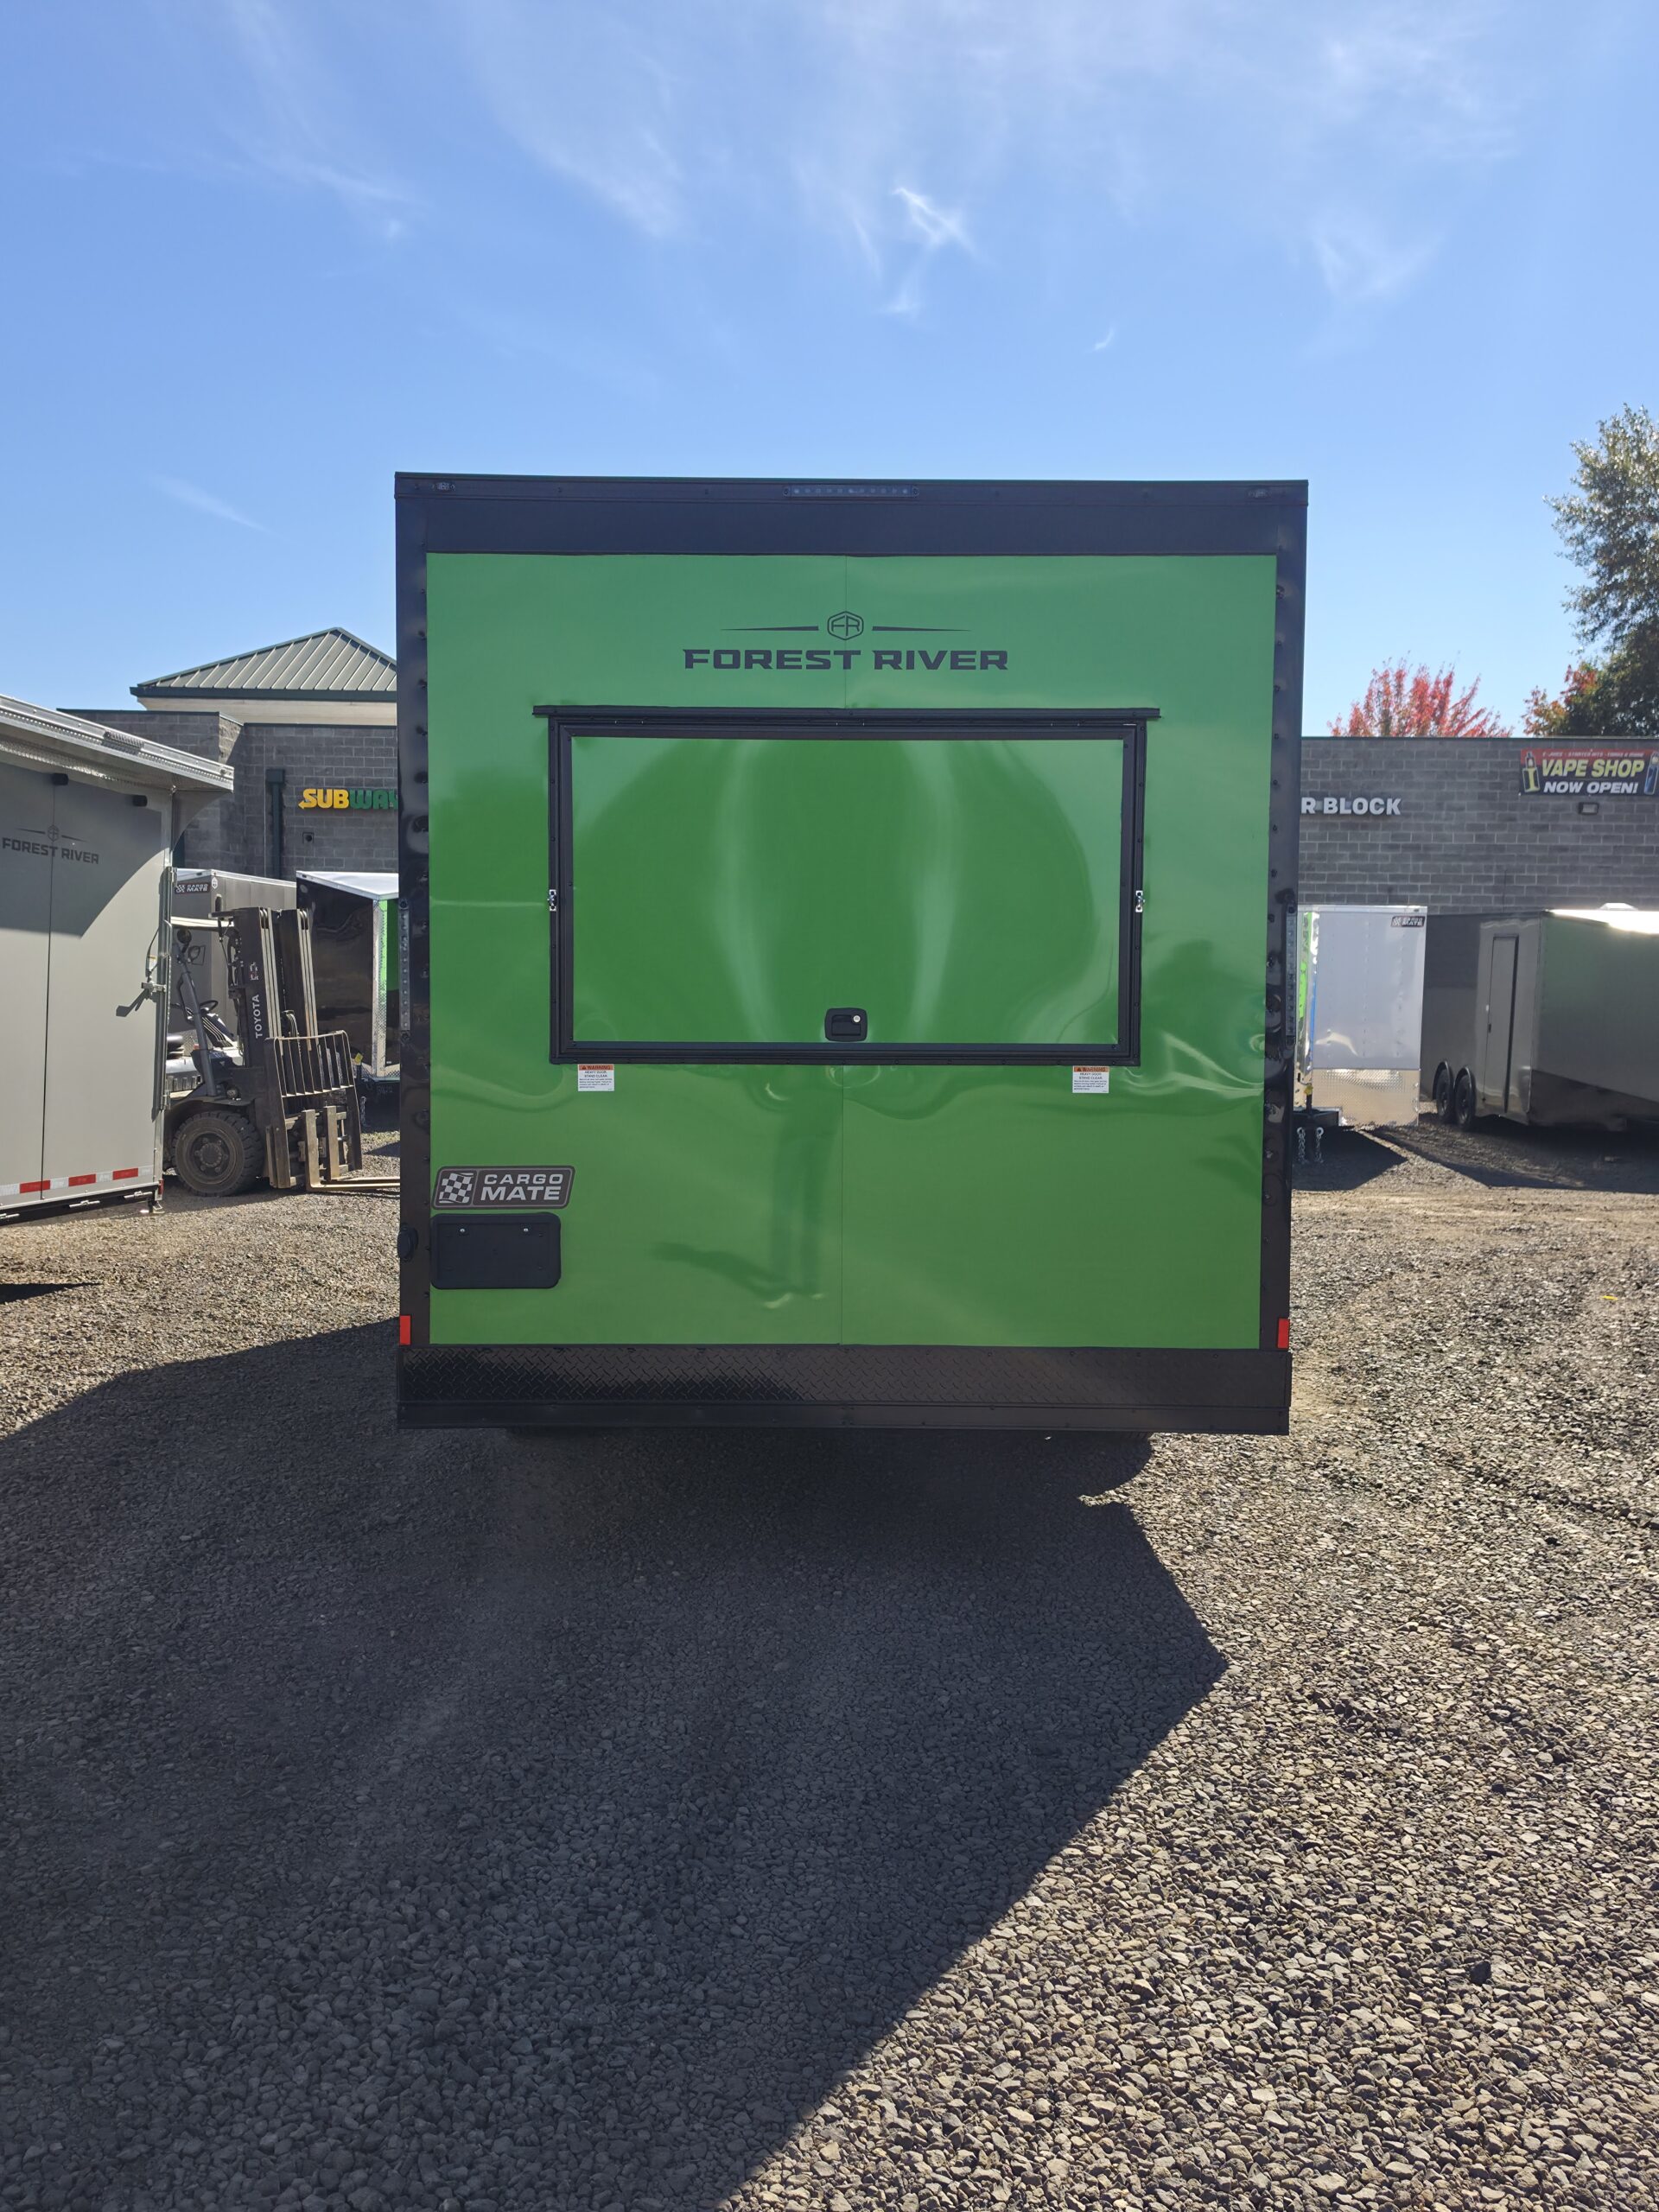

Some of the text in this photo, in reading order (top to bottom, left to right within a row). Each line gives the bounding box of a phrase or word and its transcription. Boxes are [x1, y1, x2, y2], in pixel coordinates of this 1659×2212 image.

[683, 649, 1008, 670] FOREST RIVER
[1542, 759, 1645, 778] VAPE SHOP
[1543, 781, 1639, 794] NOW OPEN!
[1323, 797, 1402, 815] BLOCK
[2, 837, 99, 864] FOREST RIVER
[252, 995, 264, 1039] TOYOTA
[484, 1173, 563, 1185] CARGO
[480, 1186, 562, 1201] MATE
